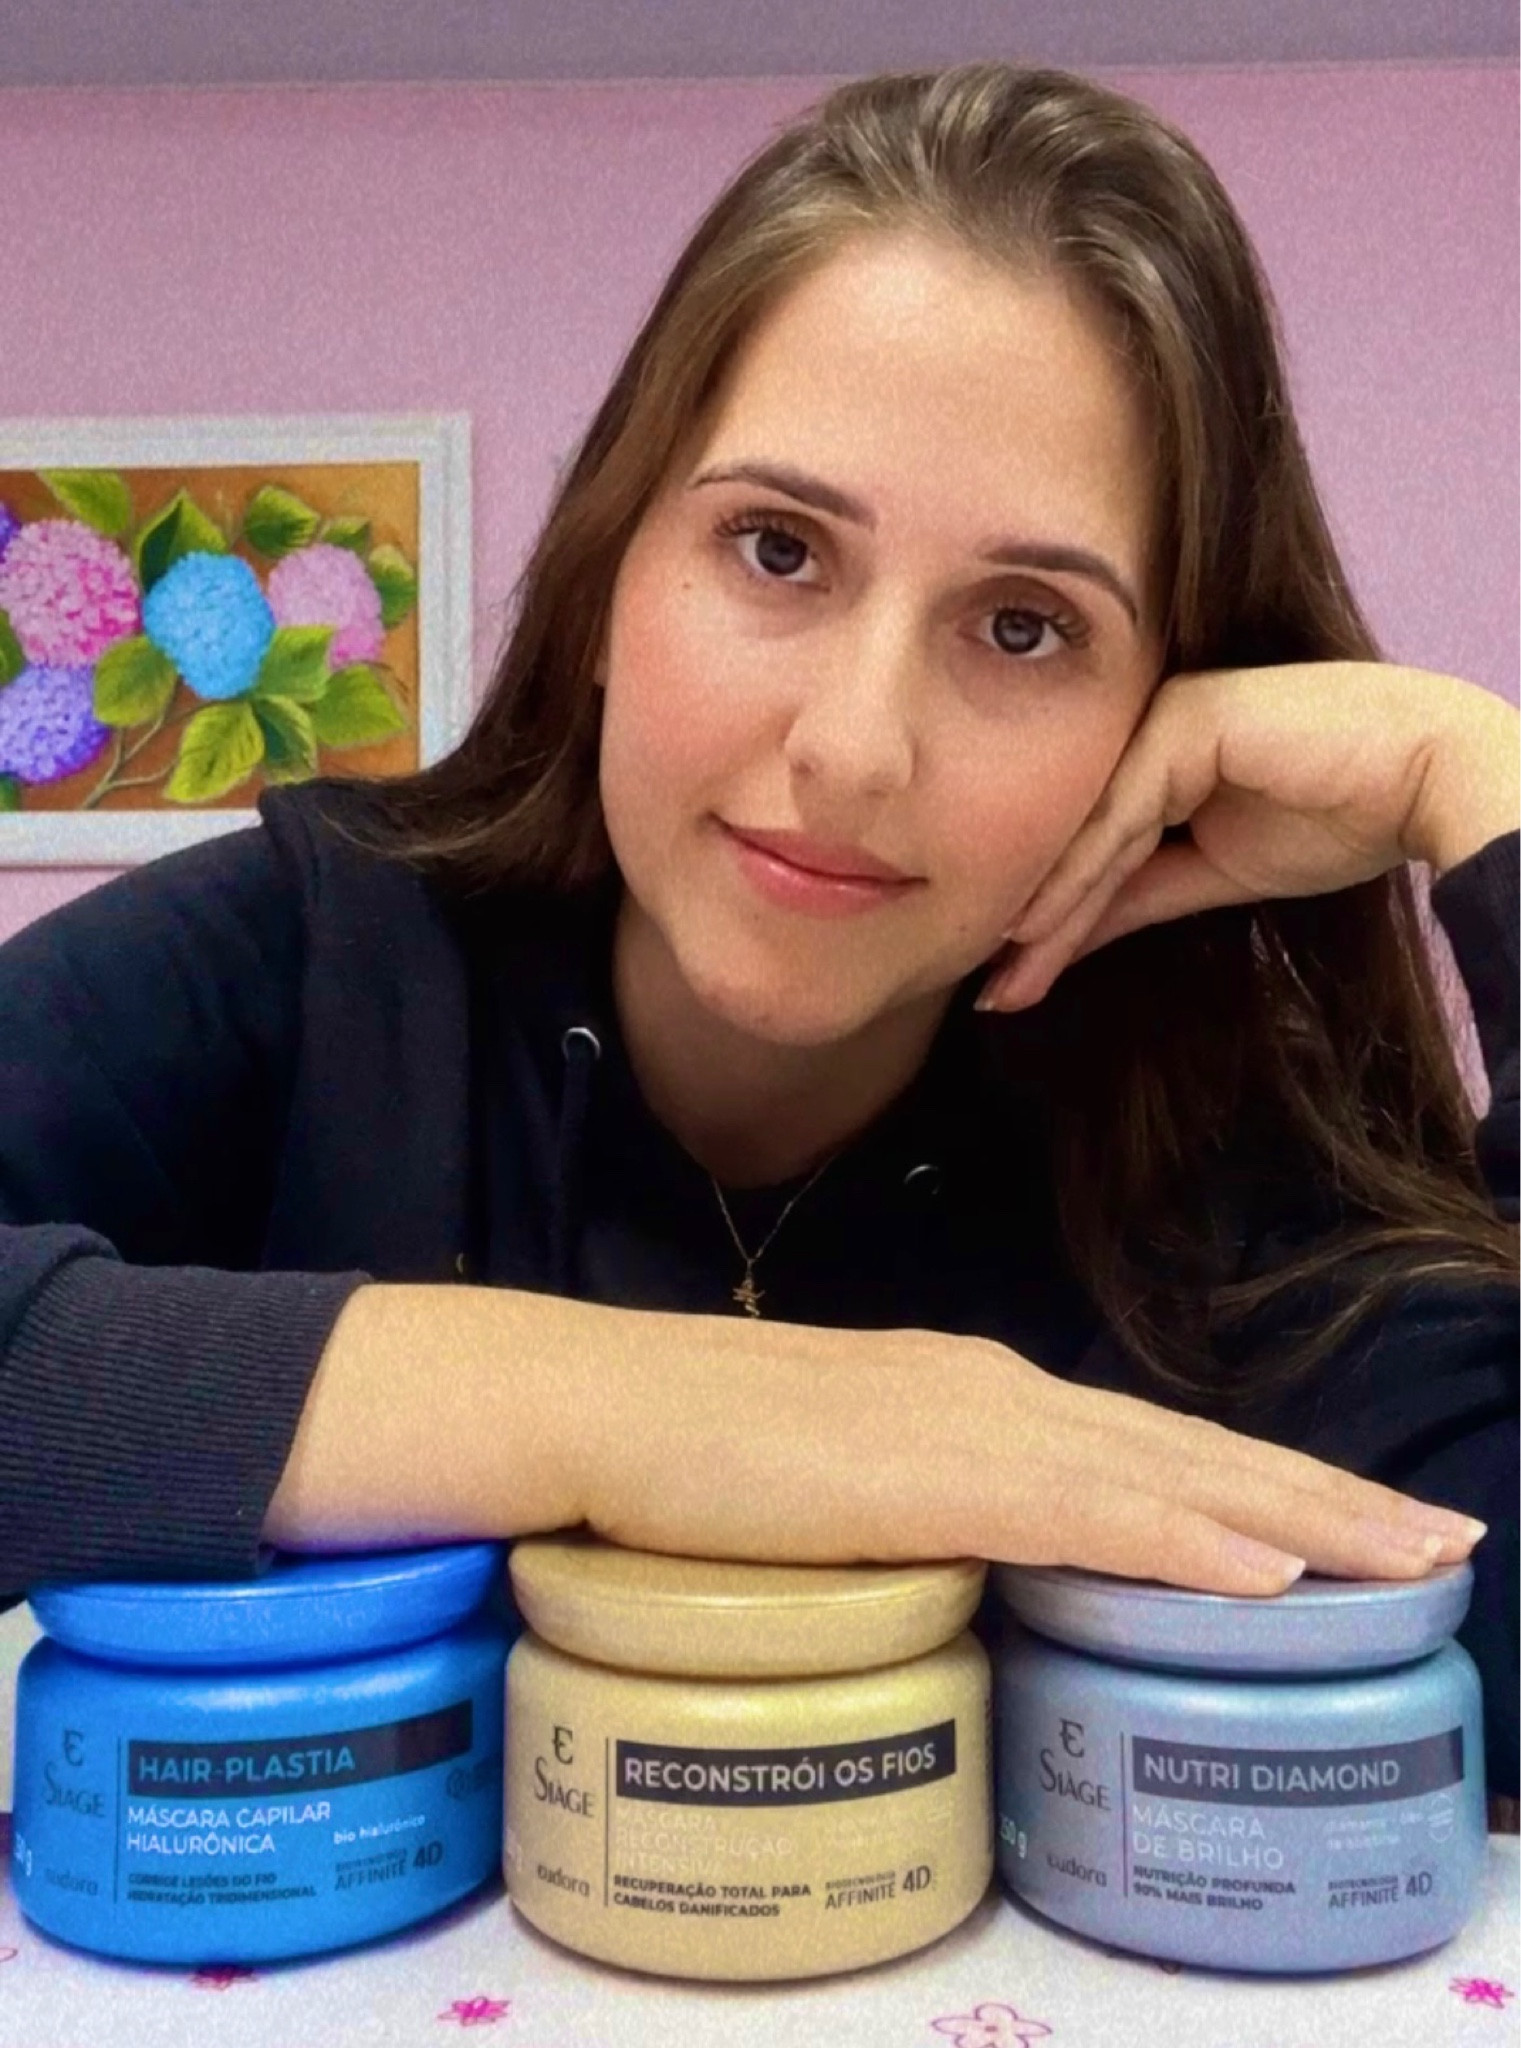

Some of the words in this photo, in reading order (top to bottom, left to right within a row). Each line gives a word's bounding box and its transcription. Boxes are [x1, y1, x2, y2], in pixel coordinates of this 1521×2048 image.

[138, 1746, 356, 1785] HAIR-PLASTIA
[624, 1756, 825, 1793] RECONSTRÓI
[834, 1756, 874, 1788] OS
[881, 1743, 936, 1780] FIOS
[1144, 1754, 1240, 1790] NUTRI
[1251, 1760, 1400, 1793] DIAMOND
[127, 1803, 230, 1829] MÁSCARA
[235, 1801, 331, 1827] CAPILAR
[1132, 1802, 1267, 1840] MÁSCARA
[126, 1830, 276, 1855] HIALURÔNICA
[333, 1826, 356, 1846] bio
[413, 1839, 443, 1869] 4D
[1132, 1832, 1167, 1859] DE
[1178, 1838, 1285, 1871] BRILHO
[613, 1875, 717, 1901] RECUPERAÇÃO
[721, 1882, 767, 1900] TOTAL
[771, 1881, 813, 1899] PARA
[902, 1865, 932, 1894] 4D
[1133, 1865, 1208, 1888] NUTRIÇÃO
[1211, 1877, 1297, 1895] PROFUNDA
[1405, 1870, 1433, 1898] 4D
[613, 1891, 675, 1914] CABELOS
[678, 1902, 781, 1919] DANIFICADOS
[1166, 1888, 1203, 1905] MAIS
[1206, 1894, 1265, 1912] BRILHO
